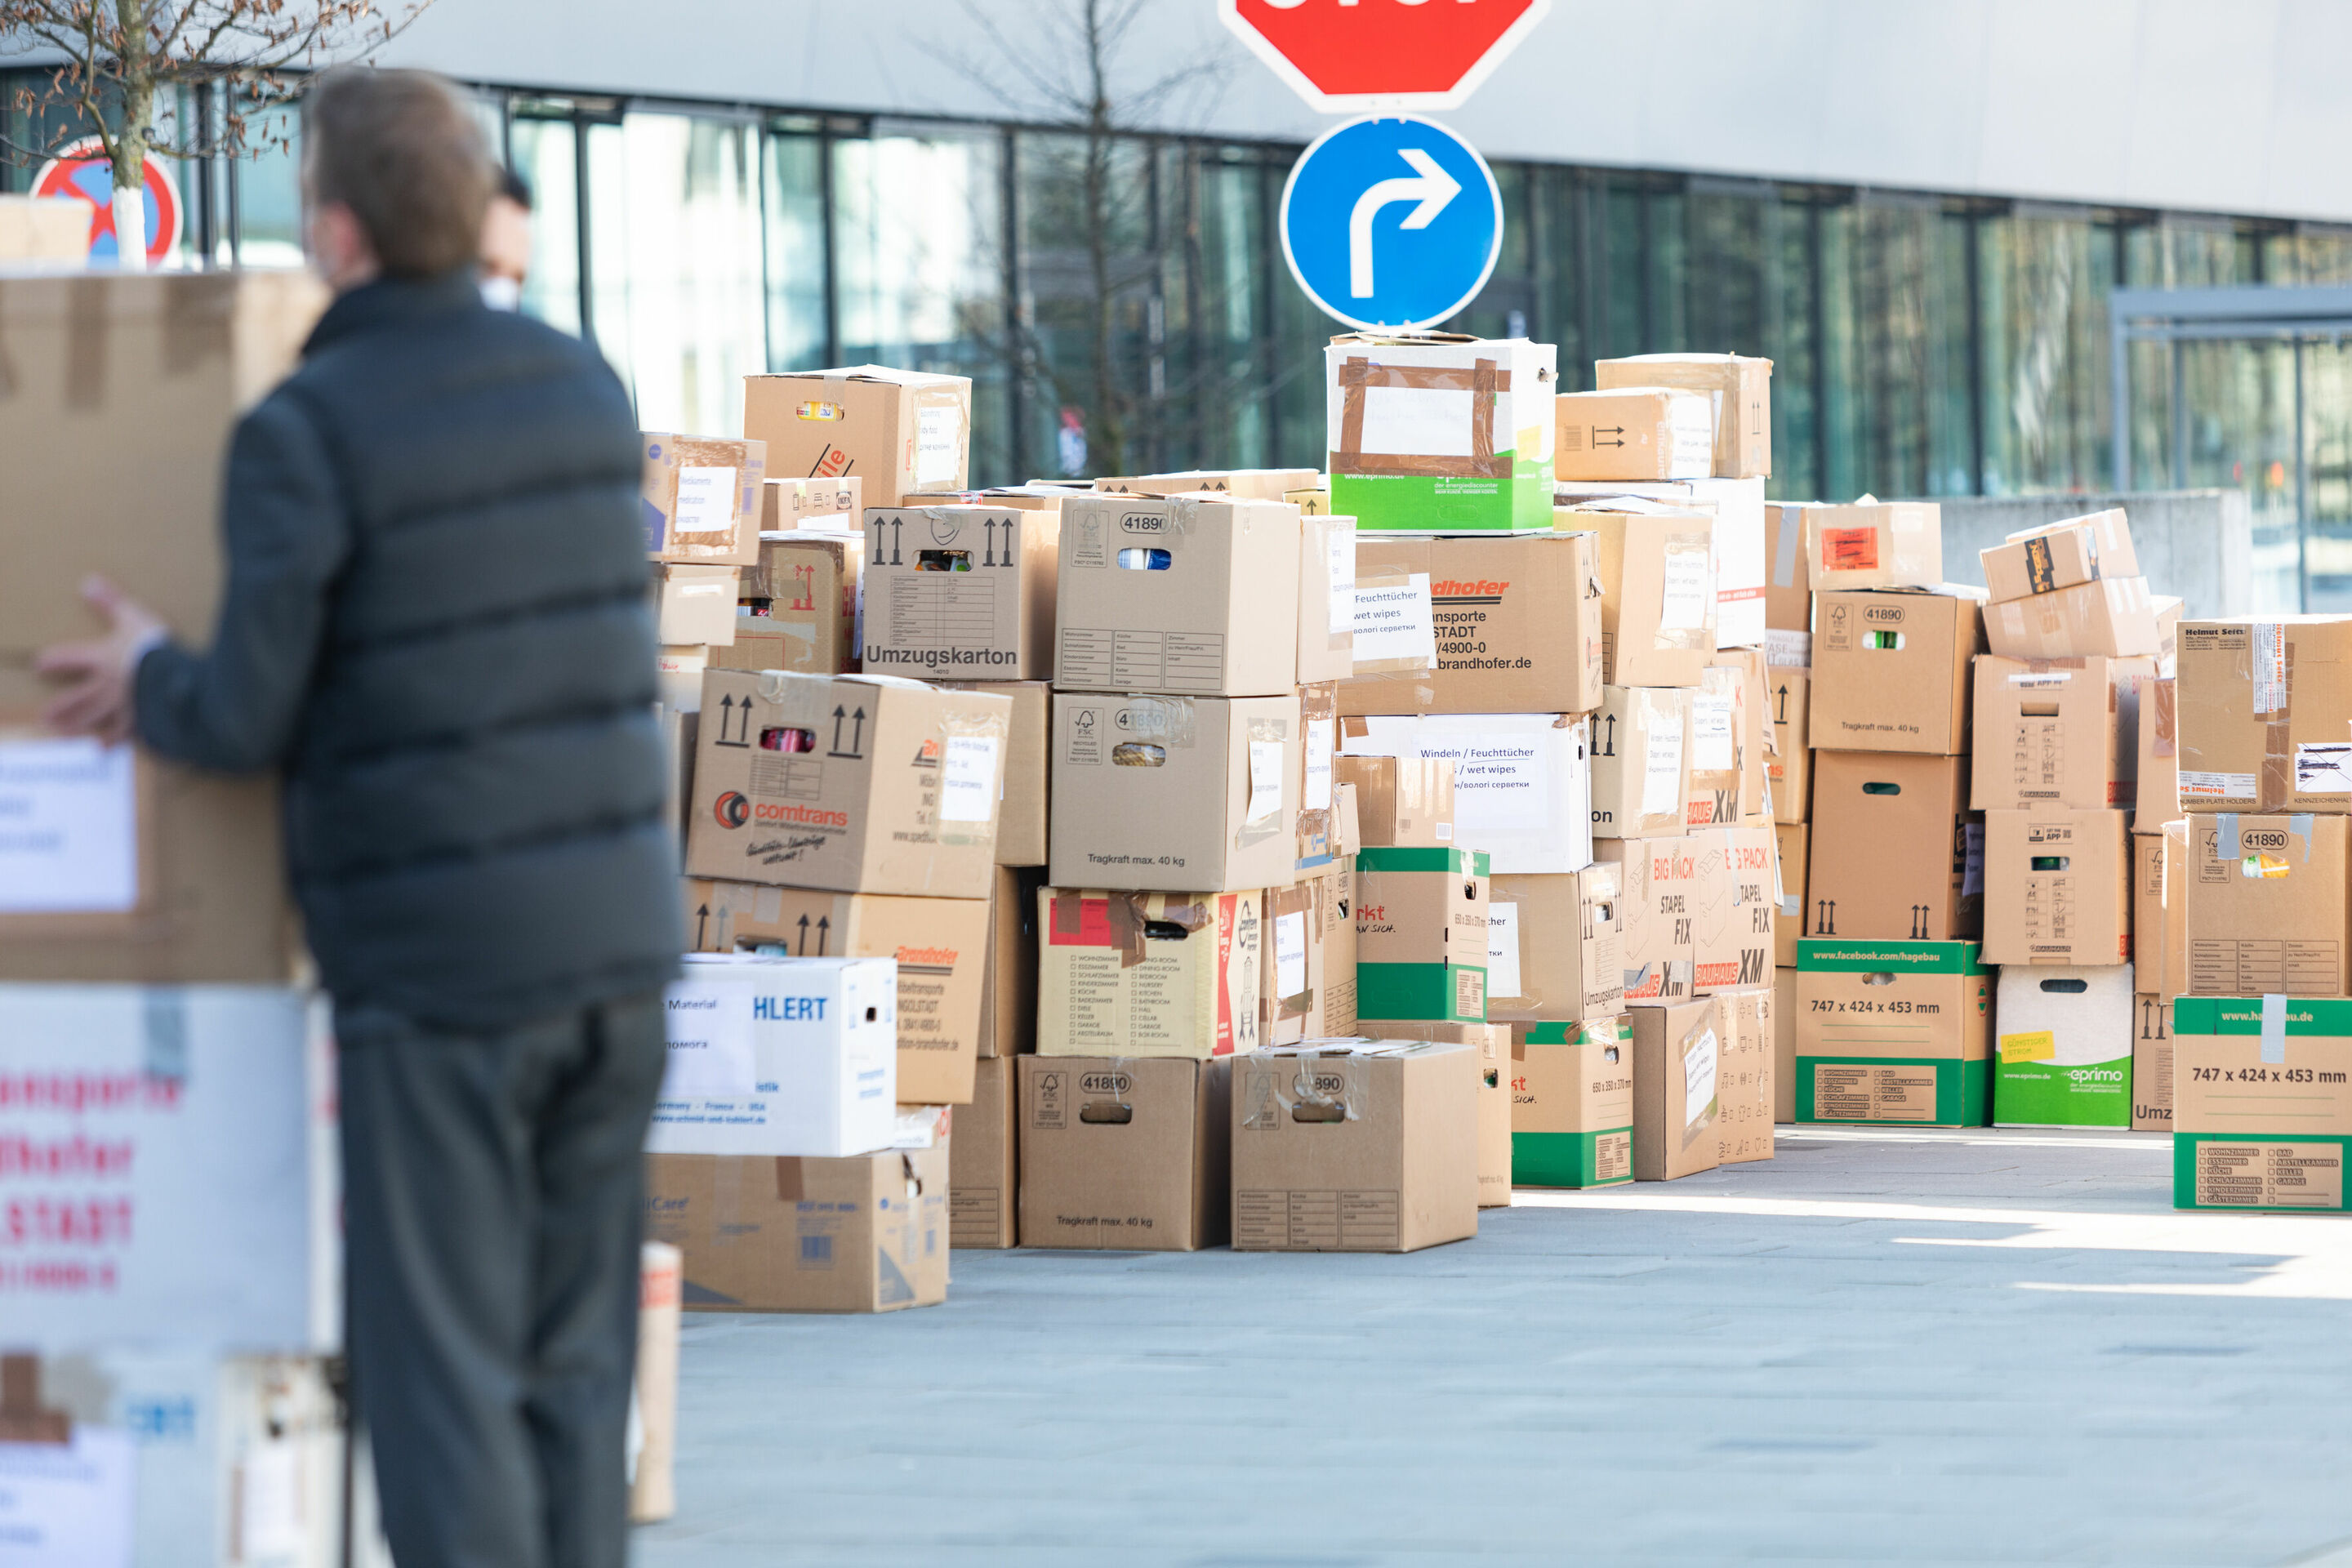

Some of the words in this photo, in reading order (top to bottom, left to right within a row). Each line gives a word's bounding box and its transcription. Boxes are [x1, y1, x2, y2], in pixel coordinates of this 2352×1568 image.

[817, 450, 845, 478] ile
[1355, 590, 1418, 604] Feuchttücher
[1352, 610, 1371, 620] wet
[1373, 608, 1401, 621] wipes
[1866, 608, 1901, 621] 41890
[1379, 623, 1416, 634] серветки
[1437, 641, 1486, 653] /4900-0
[866, 645, 1018, 668] Umzugskarton
[1437, 657, 1532, 670] brandhofer.de
[1842, 721, 1876, 732] Tragkraft
[1877, 724, 1895, 732] max.
[1898, 724, 1908, 732] 40
[1909, 725, 1919, 733] kg
[1420, 748, 1461, 758] Windeln
[1470, 748, 1535, 758] Feuchttücher
[1467, 766, 1486, 774] wet
[1488, 764, 1517, 776] wipes
[1491, 781, 1530, 791] серветки
[2191, 786, 2225, 795] Helmut
[755, 803, 848, 826] comtrans
[2245, 833, 2285, 846] 41890
[1088, 853, 1129, 866] Tragkraft
[1132, 856, 1156, 866] max.
[1158, 856, 1171, 866] 40
[1173, 857, 1185, 867] kg
[1743, 848, 1767, 869] PACK
[1654, 858, 1669, 880] BIG
[1740, 885, 1762, 902] TAPEL
[1660, 895, 1686, 915] STAPEL
[1753, 908, 1770, 933] FIX
[1370, 924, 1396, 934] SICH.
[1674, 918, 1692, 945] FIX
[1813, 951, 1940, 964] www.facebook.com/hagebau
[1695, 962, 1738, 987] BAUHAUS
[1737, 949, 1765, 984] XM
[1584, 985, 1624, 1007] Umzugskarton
[668, 1000, 717, 1011] Material
[753, 996, 828, 1021] HLERT
[1811, 1000, 1834, 1013] 747
[1838, 1004, 1846, 1013] x
[1849, 1001, 1873, 1013] 424
[1878, 1004, 1884, 1013] x
[1888, 1001, 1912, 1013] 453
[1916, 1004, 1940, 1014] mm
[2221, 1011, 2314, 1022] www.haau.de
[2007, 1037, 2048, 1048] GÜNSTIGER
[2070, 1067, 2123, 1083] eprimo
[2192, 1068, 2221, 1081] 747
[2225, 1071, 2234, 1081] x
[2238, 1068, 2267, 1082] 424
[2272, 1072, 2280, 1082] x
[2285, 1070, 2314, 1083] 453
[2319, 1072, 2347, 1083] mm
[1083, 1077, 1127, 1090] 41890
[1592, 1083, 1601, 1094] 650
[1606, 1080, 1614, 1093] 350
[1617, 1078, 1625, 1089] 370
[1625, 1080, 1632, 1089] mm
[704, 1102, 734, 1111] France
[748, 1102, 766, 1111] USA
[1512, 1096, 1537, 1104] SICH.
[2207, 1148, 2260, 1156] WOHNZIMMER
[2277, 1159, 2339, 1167] ABSTELLKAMMER
[2207, 1166, 2232, 1174] KÜCHE
[2277, 1178, 2306, 1186] GARAGE
[2207, 1196, 2259, 1204] GÄSTEZIMMER
[1057, 1216, 1098, 1228] Tragkraft
[1101, 1218, 1124, 1227] max.
[1126, 1217, 1138, 1227] 40
[1140, 1217, 1153, 1228] kg
